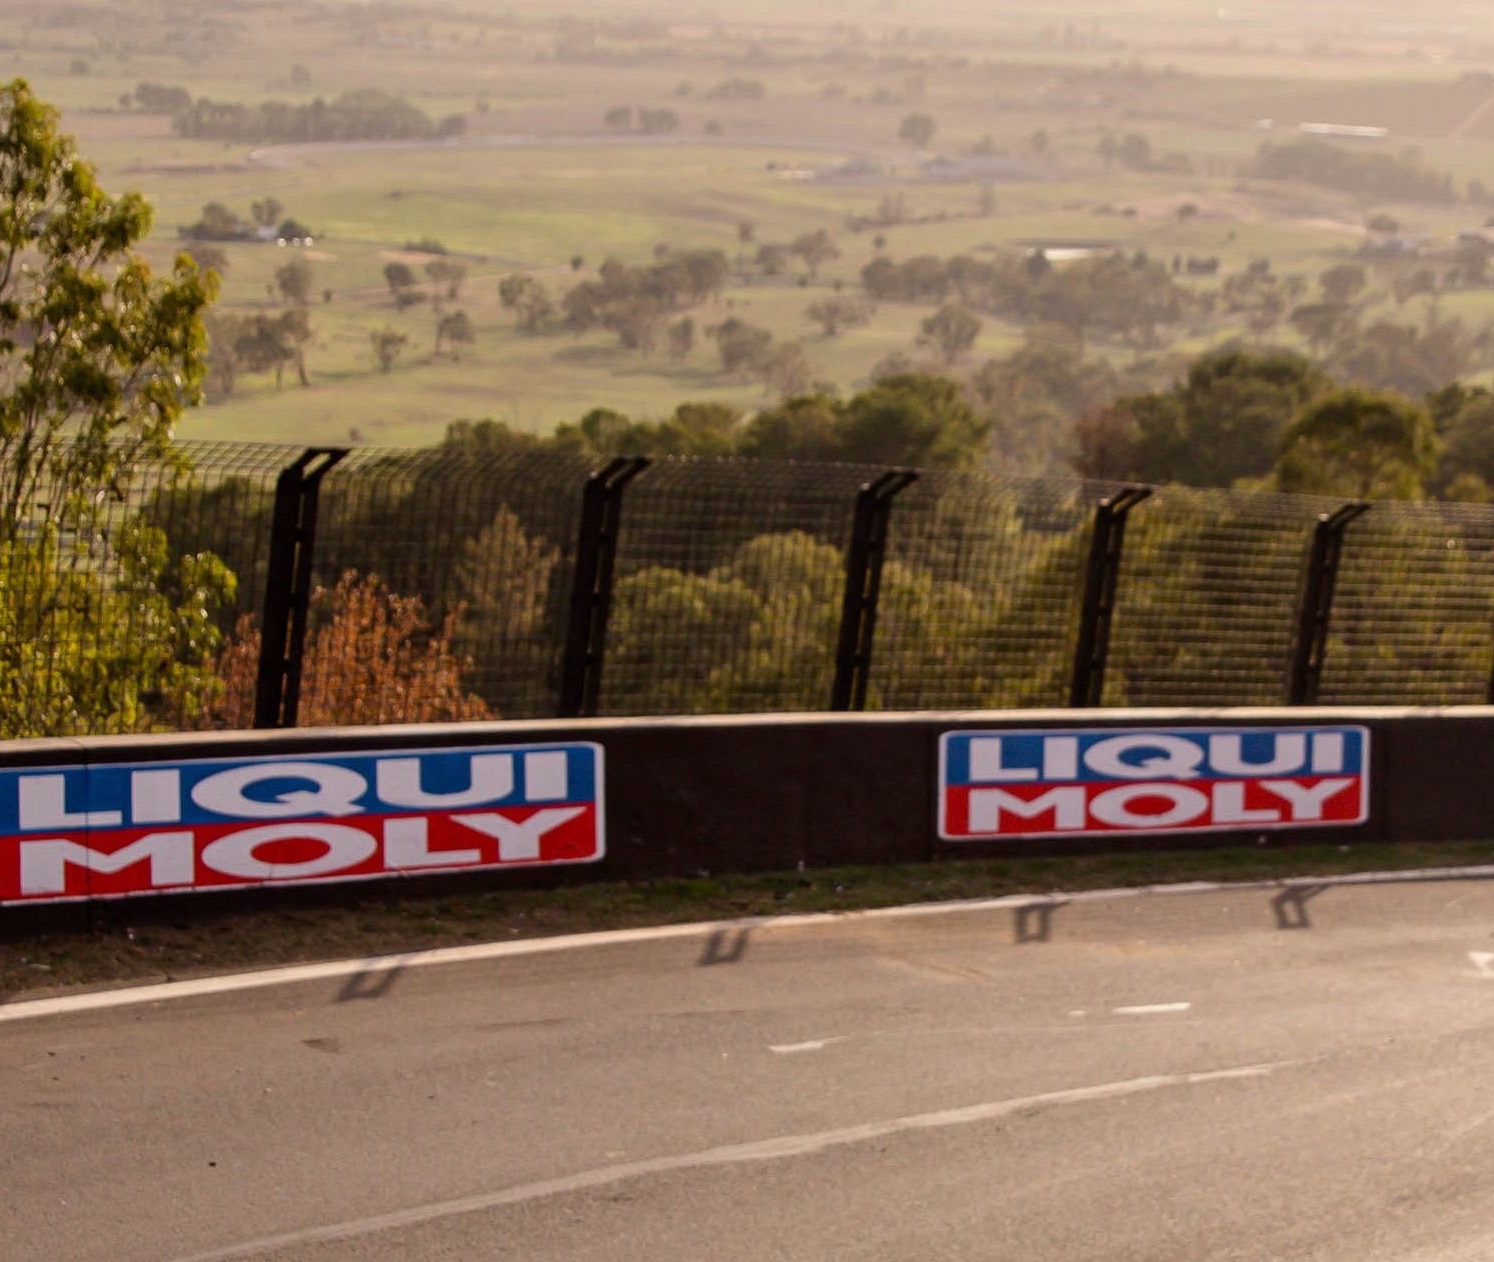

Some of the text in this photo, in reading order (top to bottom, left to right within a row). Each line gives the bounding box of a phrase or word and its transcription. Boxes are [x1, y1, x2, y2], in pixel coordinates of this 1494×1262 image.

[18, 750, 568, 830] LIQUI
[969, 733, 1345, 781] LIQUI
[968, 778, 1355, 834] MOLY
[20, 807, 587, 896] MOLY
